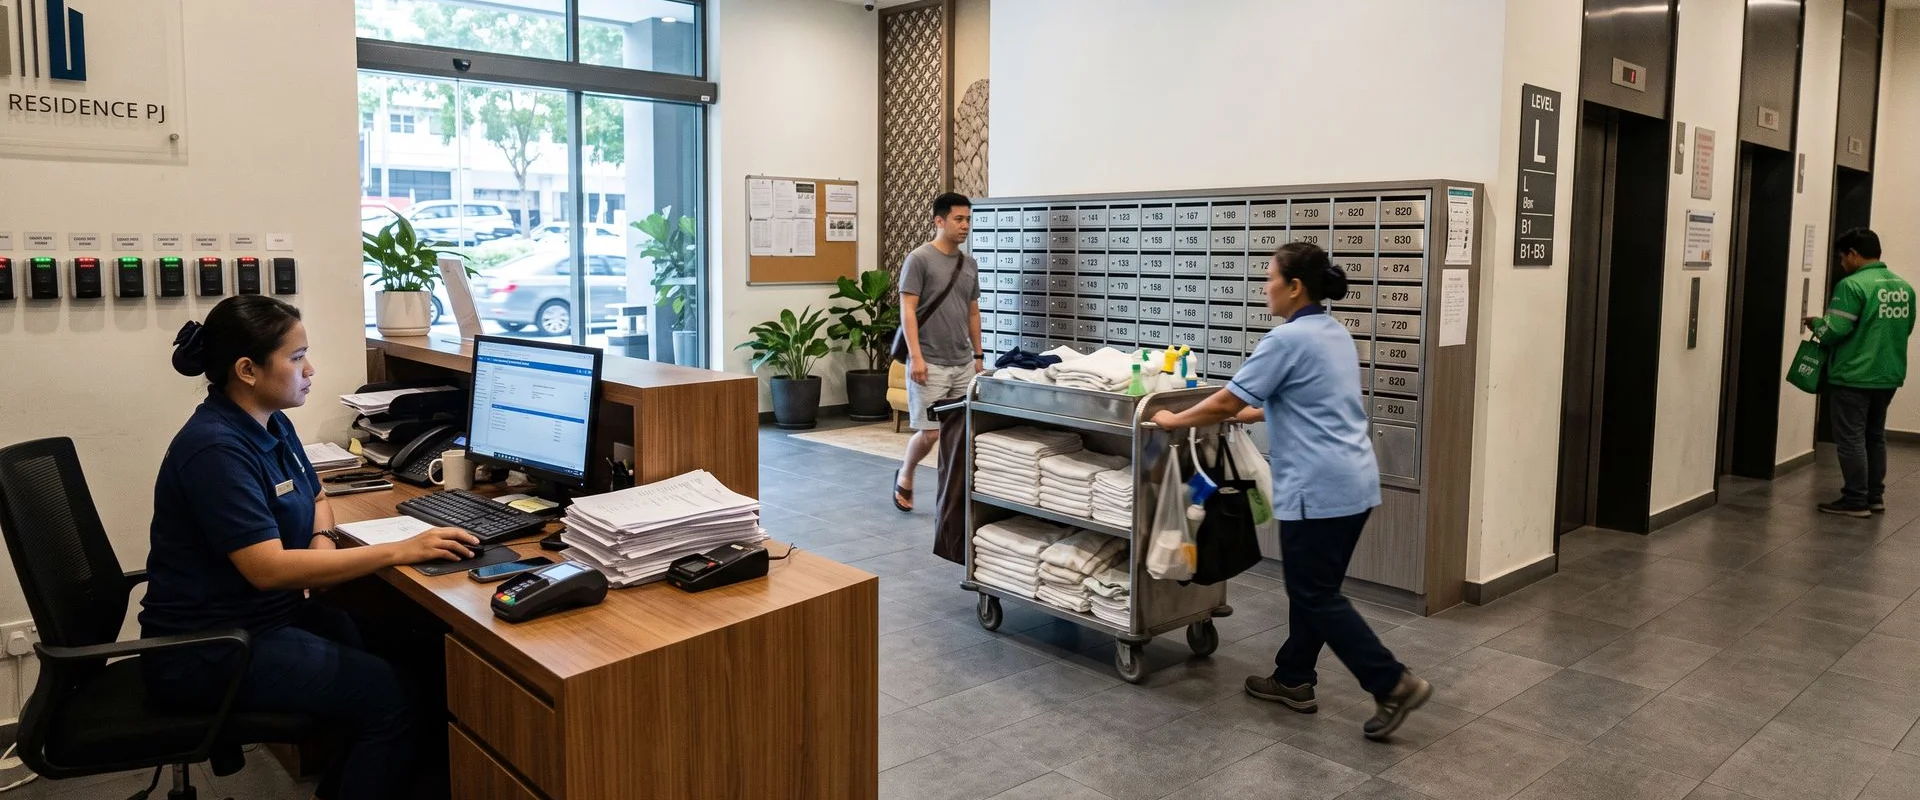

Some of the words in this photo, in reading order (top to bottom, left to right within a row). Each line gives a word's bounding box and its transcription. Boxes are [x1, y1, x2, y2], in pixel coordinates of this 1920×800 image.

[1531, 93, 1554, 112] LEVEL
[9, 93, 138, 119] RESIDENCE
[147, 104, 165, 124] PJ
[1534, 118, 1546, 164] L
[1523, 176, 1529, 192] L
[1303, 209, 1319, 217] 730
[1348, 208, 1364, 216] 820
[1395, 207, 1412, 216] 820
[1521, 218, 1532, 234] B1
[1222, 236, 1235, 244] 150
[1261, 236, 1276, 244] 670
[1394, 235, 1411, 244] 830
[1346, 263, 1362, 271] 730
[1392, 264, 1410, 272] 874
[1345, 291, 1361, 299] 770
[1391, 292, 1409, 301] 878
[1877, 287, 1909, 303] Grab
[1878, 303, 1909, 319] Food
[1344, 318, 1360, 327] 778
[1391, 320, 1407, 330] 720
[1389, 349, 1407, 358] 820
[1388, 377, 1405, 386] 820
[1387, 405, 1404, 414] 820
